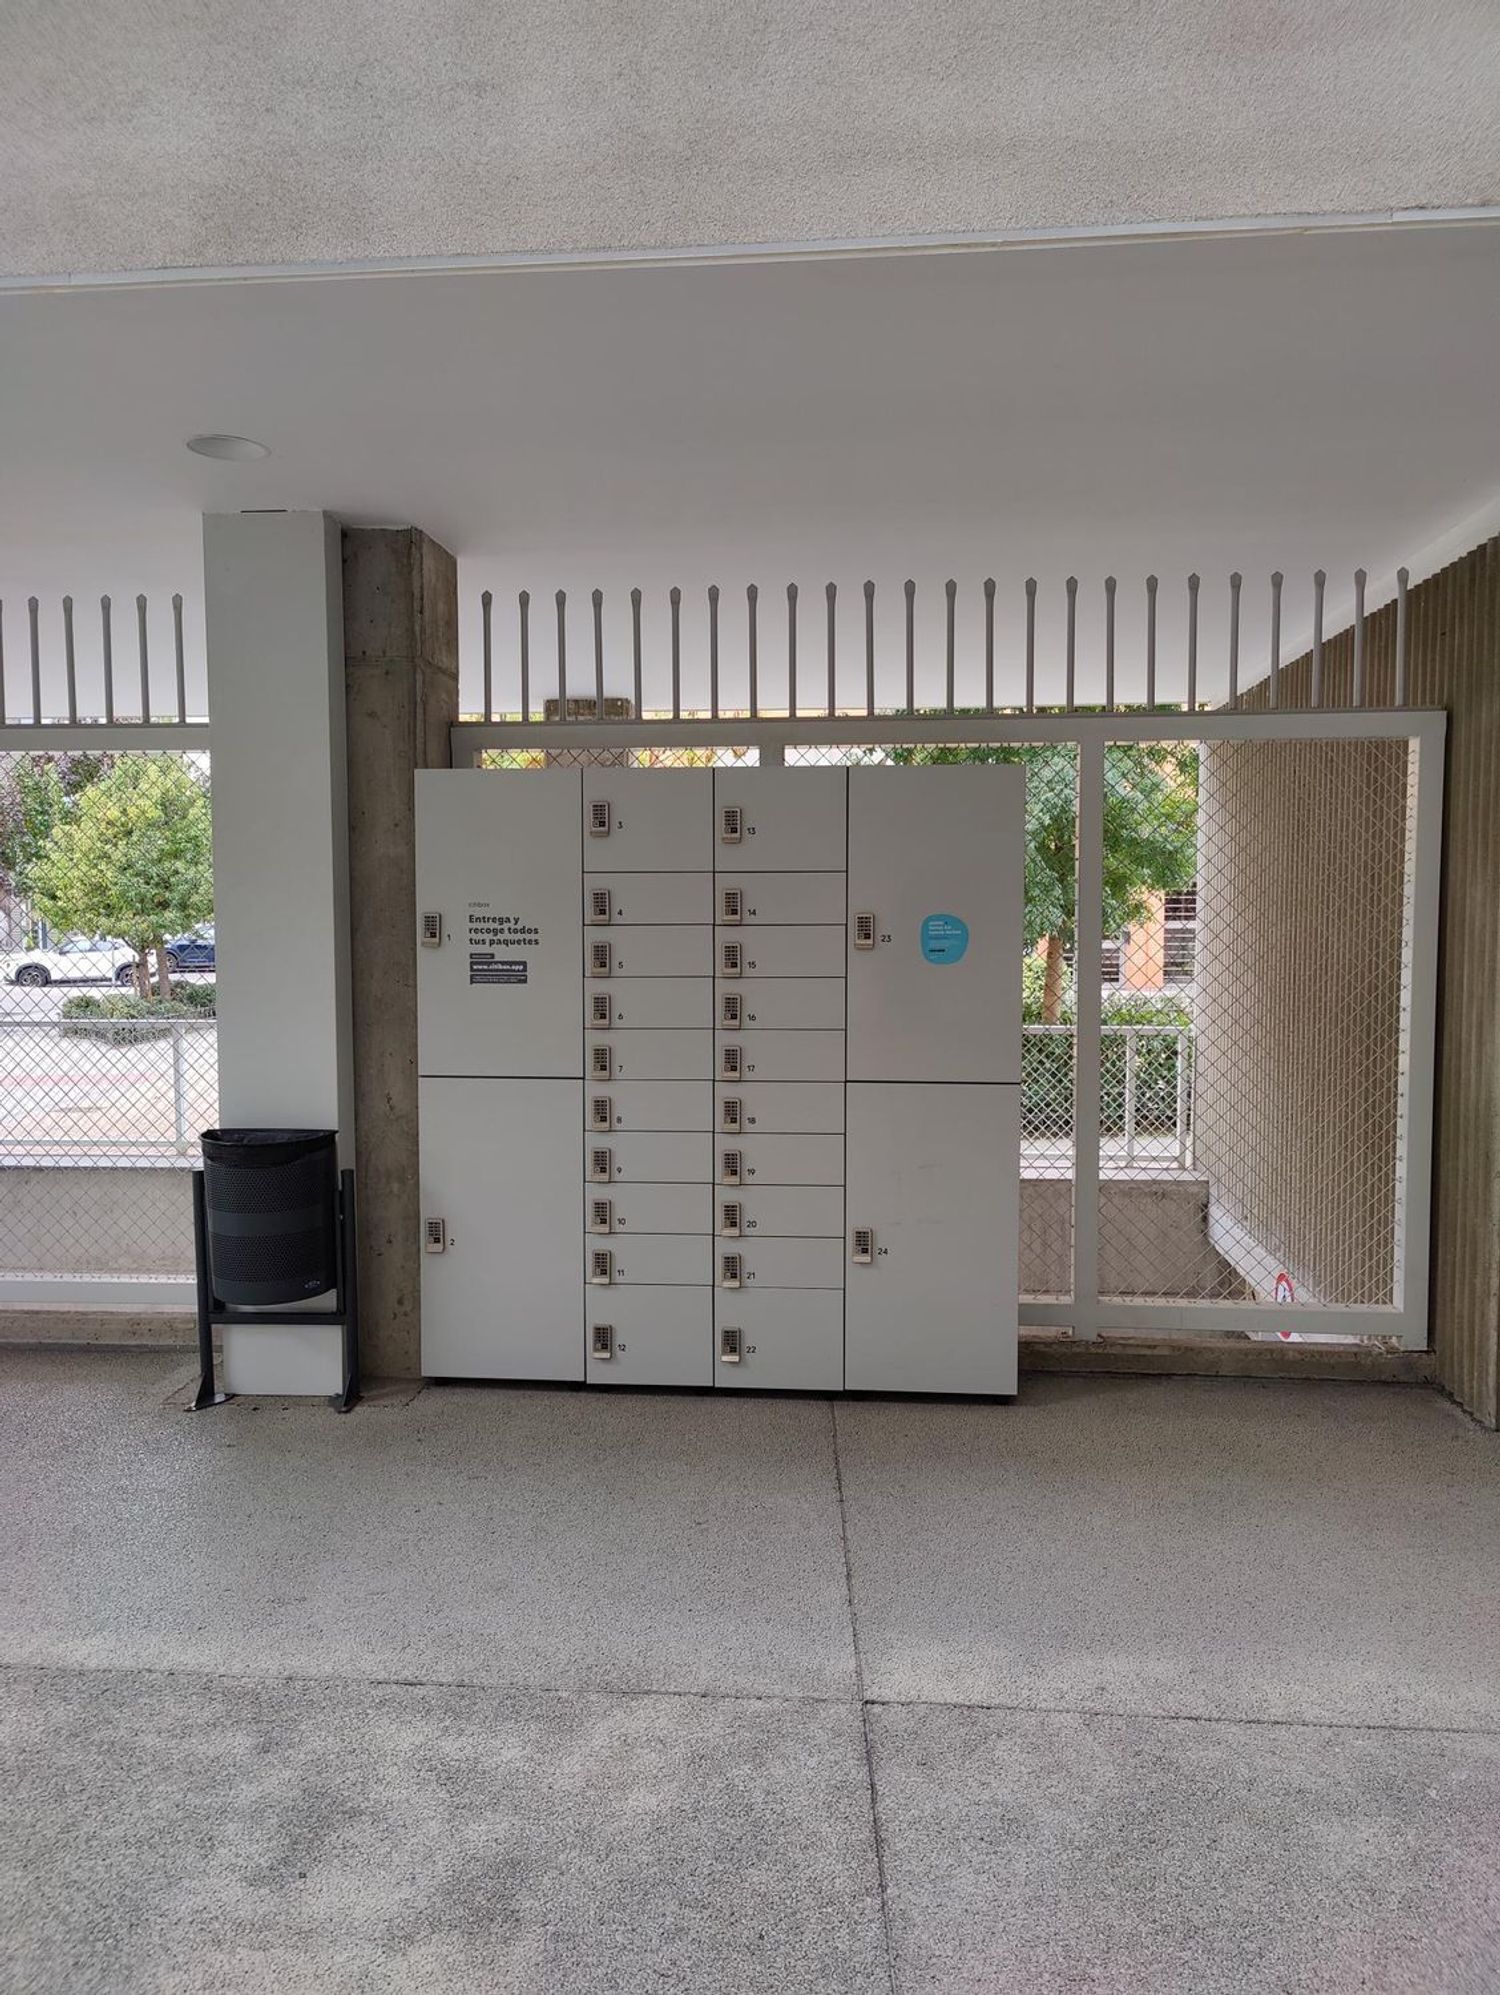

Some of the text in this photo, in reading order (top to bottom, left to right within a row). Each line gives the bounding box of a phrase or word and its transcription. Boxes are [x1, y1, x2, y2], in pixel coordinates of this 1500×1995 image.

[746, 826, 757, 835] 13
[747, 908, 757, 917] 14
[469, 914, 520, 926] Entrega y
[469, 926, 539, 936] recoge todos
[489, 938, 540, 947] paquetes
[880, 934, 892, 943] 23
[747, 961, 757, 969] 15
[747, 1013, 757, 1022] 16
[746, 1064, 756, 1072] 17
[746, 1116, 757, 1125] 18
[746, 1168, 756, 1176] 19
[616, 1217, 627, 1226] 10
[746, 1220, 758, 1228] 20
[877, 1247, 888, 1256] 24
[617, 1269, 625, 1277] 11
[746, 1271, 756, 1280] 21
[617, 1343, 626, 1352] 12
[745, 1345, 757, 1354] 22
